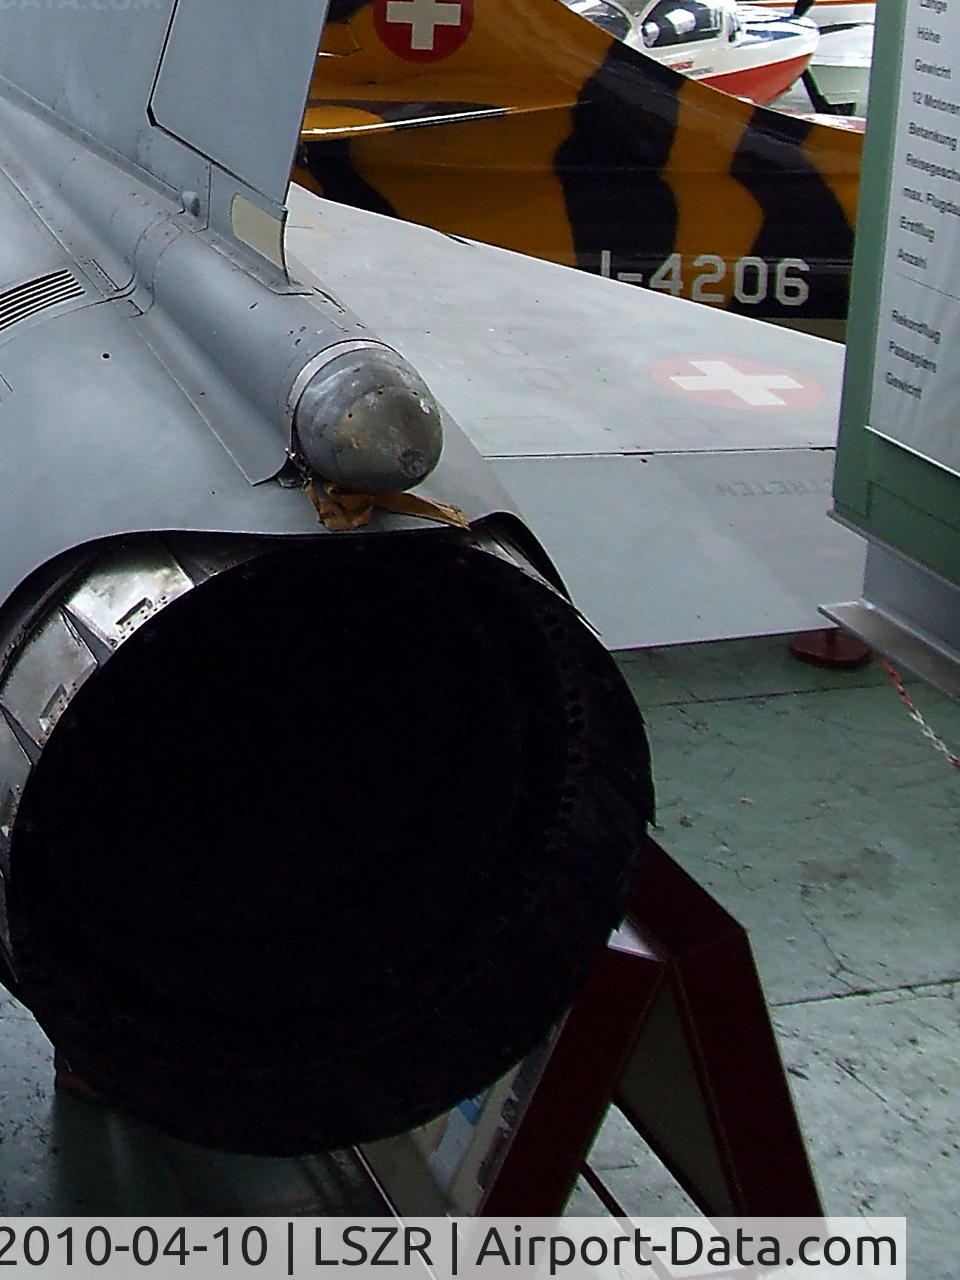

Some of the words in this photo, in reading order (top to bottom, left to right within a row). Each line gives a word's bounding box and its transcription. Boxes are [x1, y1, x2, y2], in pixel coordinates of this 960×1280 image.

[917, 26, 941, 45] Höhe
[914, 58, 951, 80] Gewicht
[912, 91, 922, 105] 12
[908, 122, 957, 151] Betankung
[900, 216, 935, 243] Erstflug
[898, 248, 927, 270] Anzahl
[892, 309, 941, 345] Rekordflug
[886, 371, 922, 400] Gewicht
